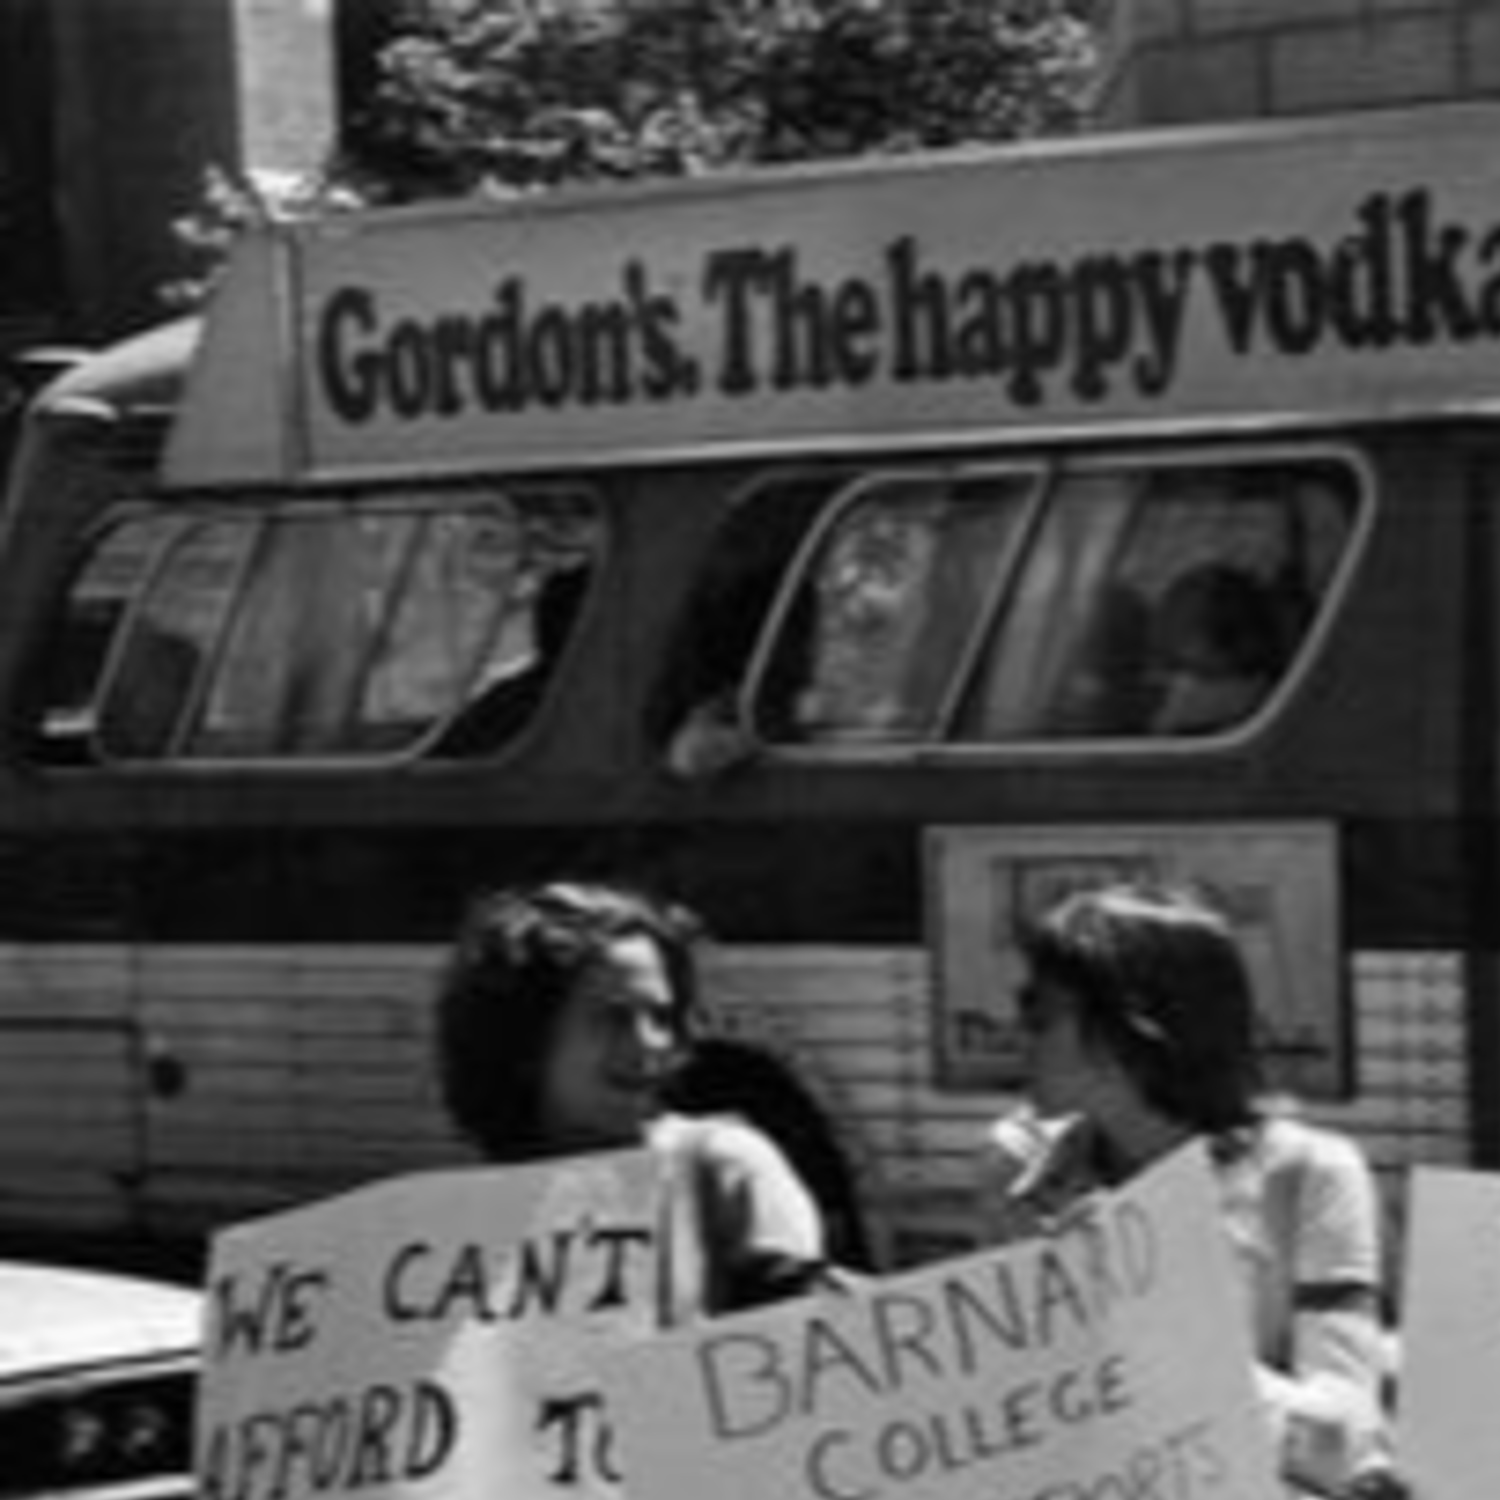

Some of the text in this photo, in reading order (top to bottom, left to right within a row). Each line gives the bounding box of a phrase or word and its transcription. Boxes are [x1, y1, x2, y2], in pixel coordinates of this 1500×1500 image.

[317, 256, 700, 422] Gordon's.
[703, 246, 882, 396] The
[885, 237, 1197, 403] happy
[214, 1262, 328, 1361] WE
[697, 1203, 1158, 1441] BARNARD
